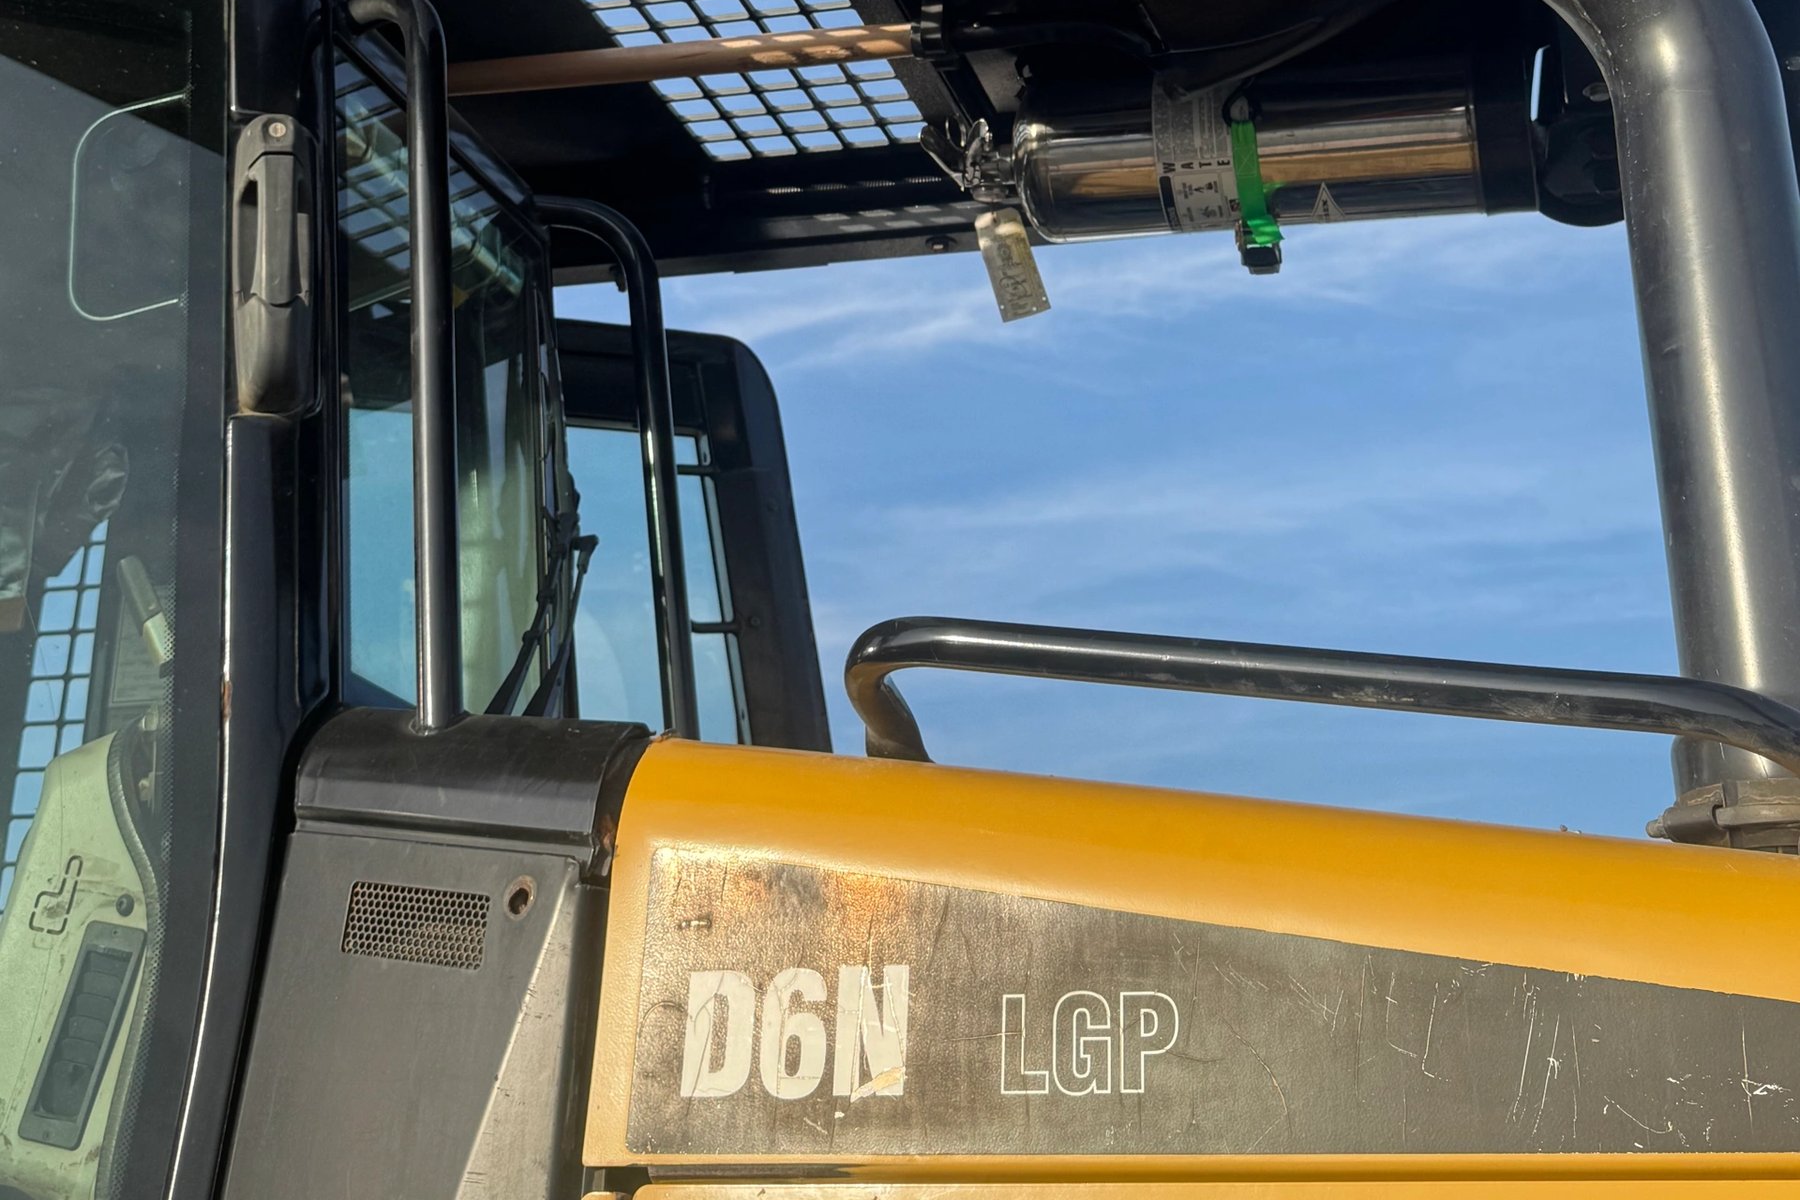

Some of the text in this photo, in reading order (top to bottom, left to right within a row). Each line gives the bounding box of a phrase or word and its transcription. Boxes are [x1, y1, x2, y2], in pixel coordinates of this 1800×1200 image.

[1162, 159, 1232, 174] WATE
[680, 965, 1179, 1100] D6N LGP
